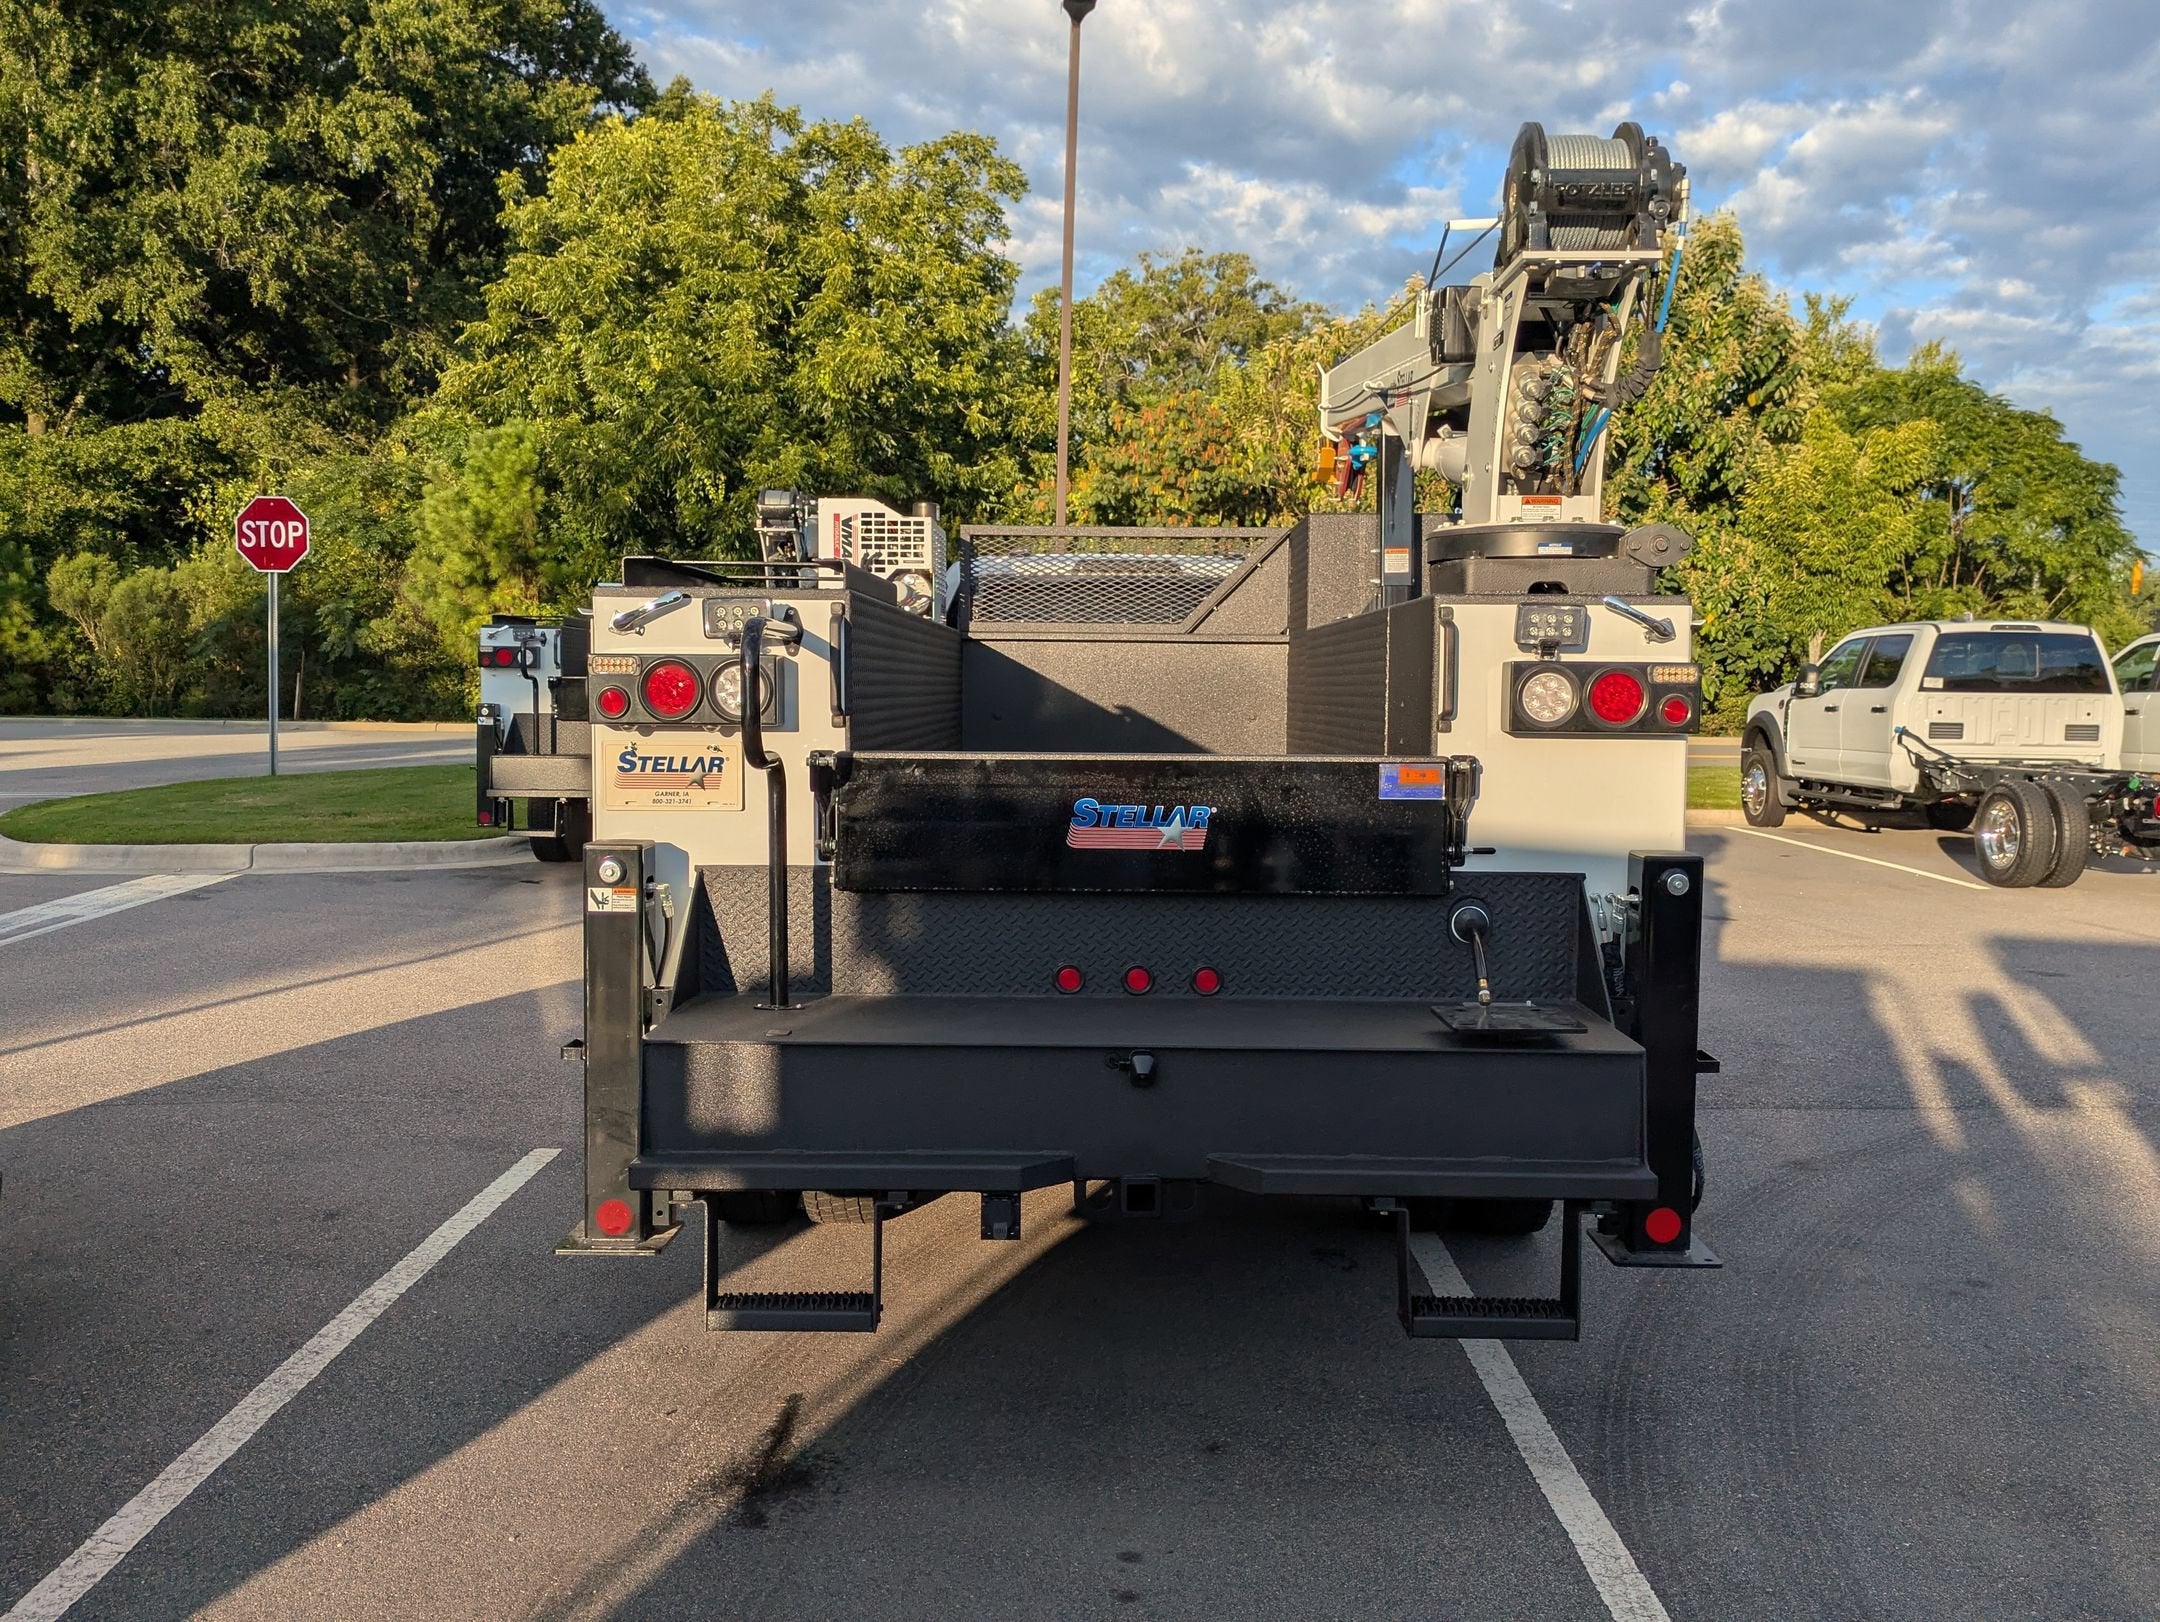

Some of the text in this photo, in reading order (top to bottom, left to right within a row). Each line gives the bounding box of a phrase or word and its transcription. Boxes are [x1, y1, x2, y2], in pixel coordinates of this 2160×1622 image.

[241, 520, 304, 548] STOP
[617, 750, 725, 773] STELLAR
[1071, 797, 1211, 828] STELLAR
